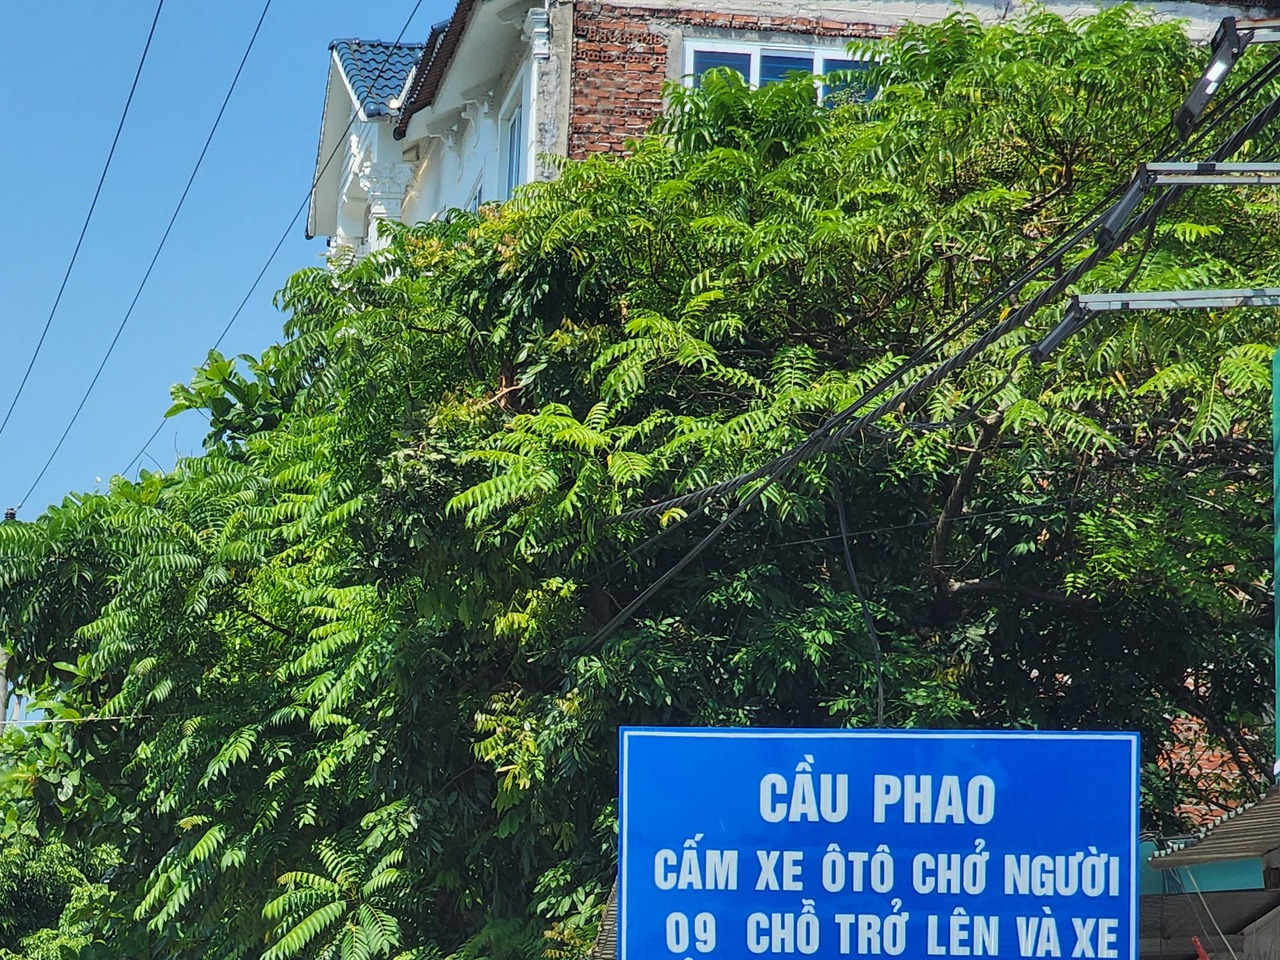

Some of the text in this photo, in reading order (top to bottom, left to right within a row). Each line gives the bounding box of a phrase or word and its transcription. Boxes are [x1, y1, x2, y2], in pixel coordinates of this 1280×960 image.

[760, 754, 996, 825] CẦU PHAO
[654, 833, 1120, 898] CẤM XE ÔTÔ CHỞ NGƯỜI
[665, 898, 1119, 959] 09 CHỖ TRỞ LÊN VÀ XE
